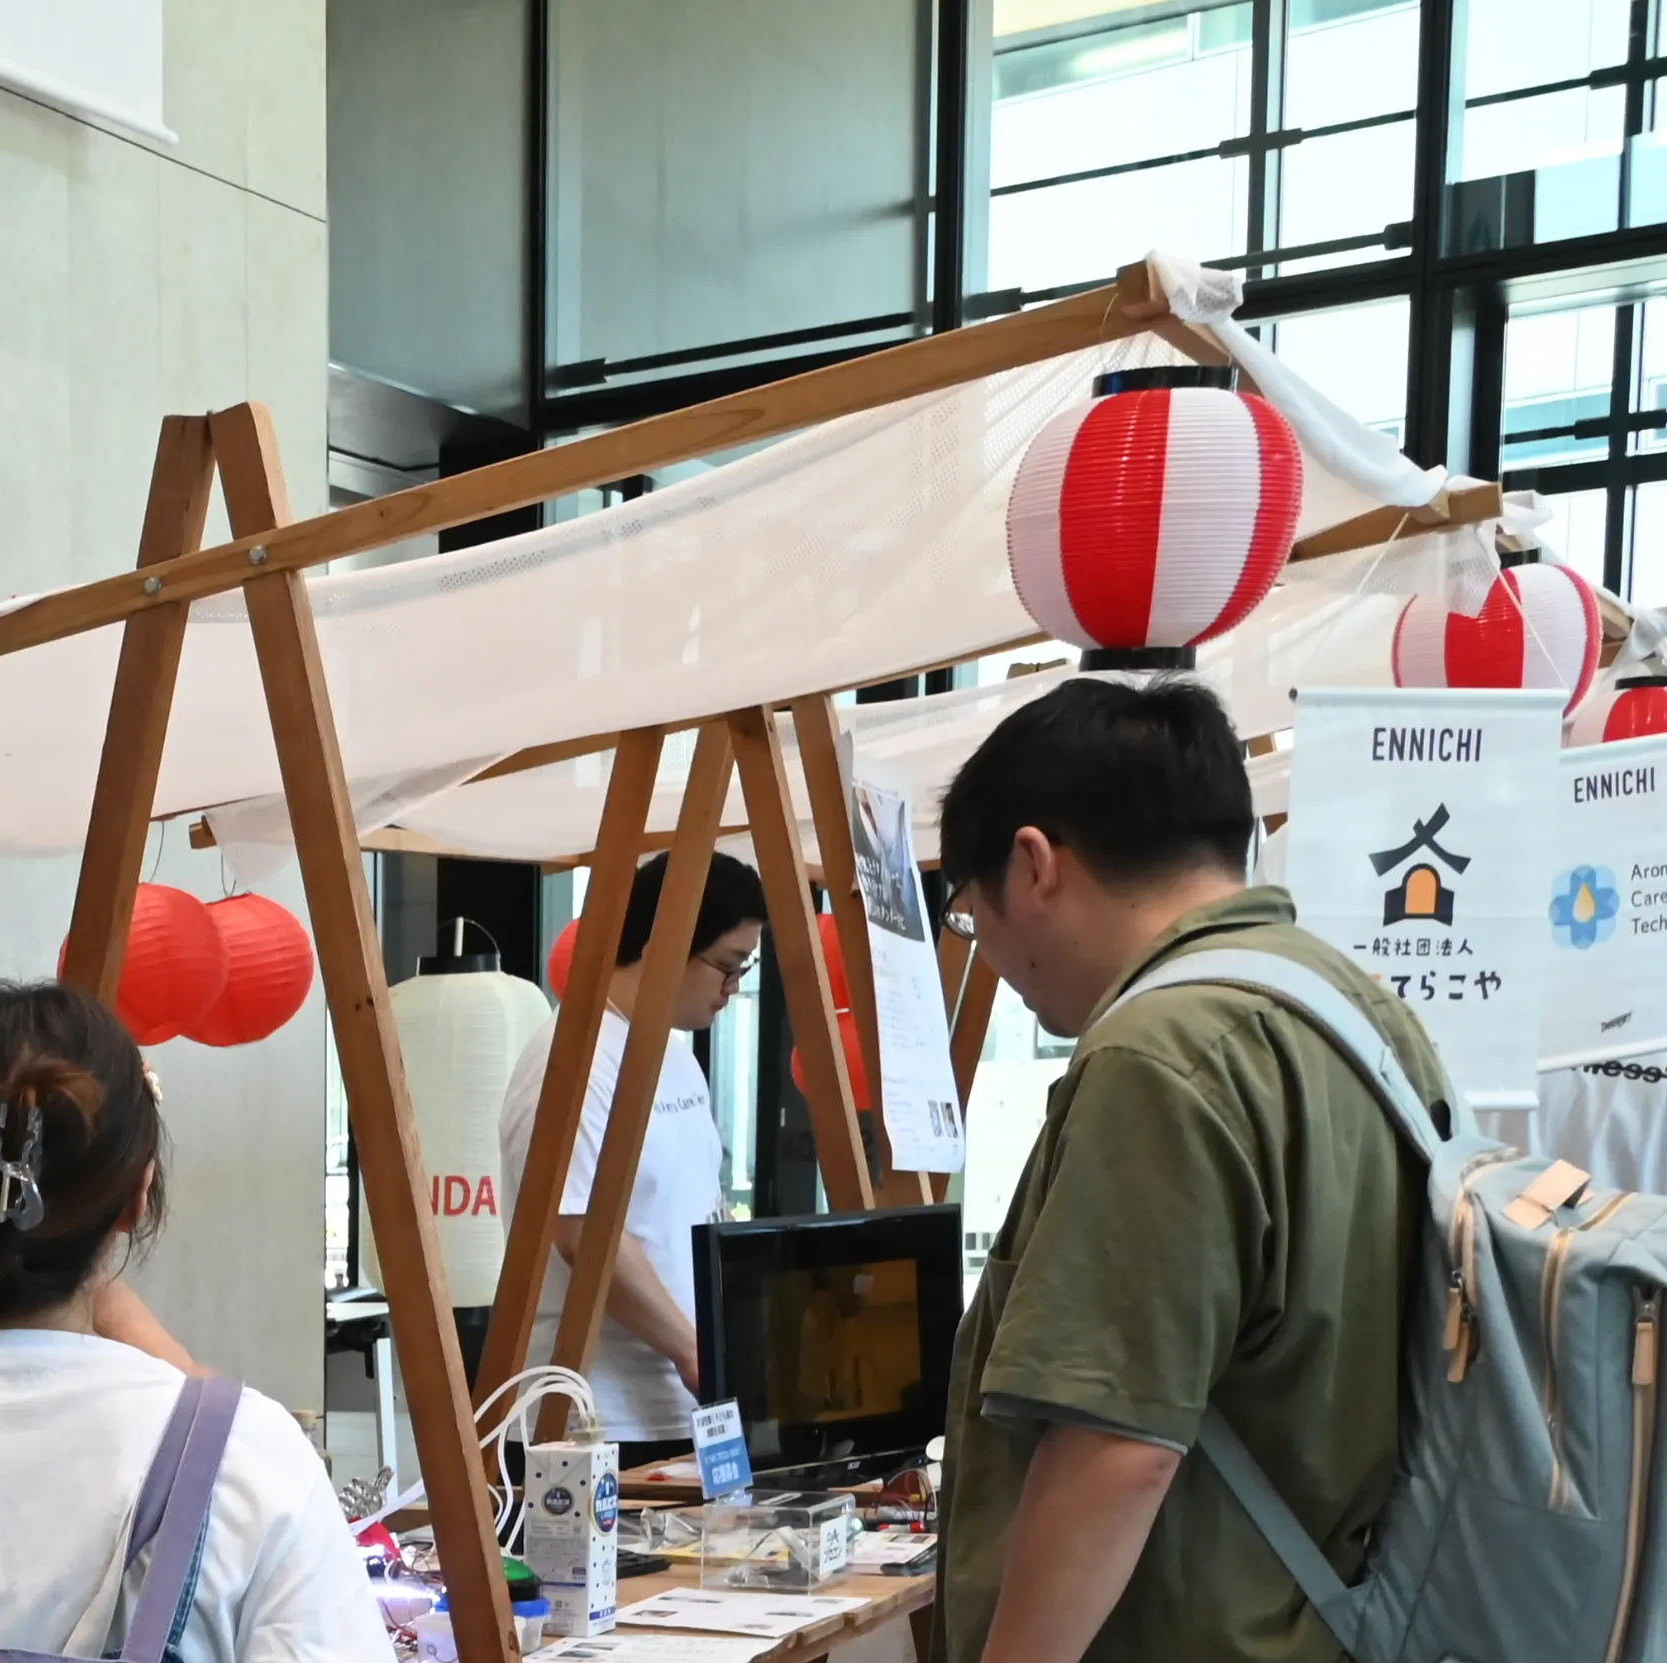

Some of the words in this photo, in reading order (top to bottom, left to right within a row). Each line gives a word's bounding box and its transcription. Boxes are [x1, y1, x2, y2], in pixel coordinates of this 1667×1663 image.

[1371, 726, 1484, 764] ENNICHI
[1573, 766, 1656, 804] ENNICHI
[1630, 889, 1667, 908] Care
[1353, 936, 1474, 957] 一般社団法人
[1368, 970, 1502, 1001] てらこや
